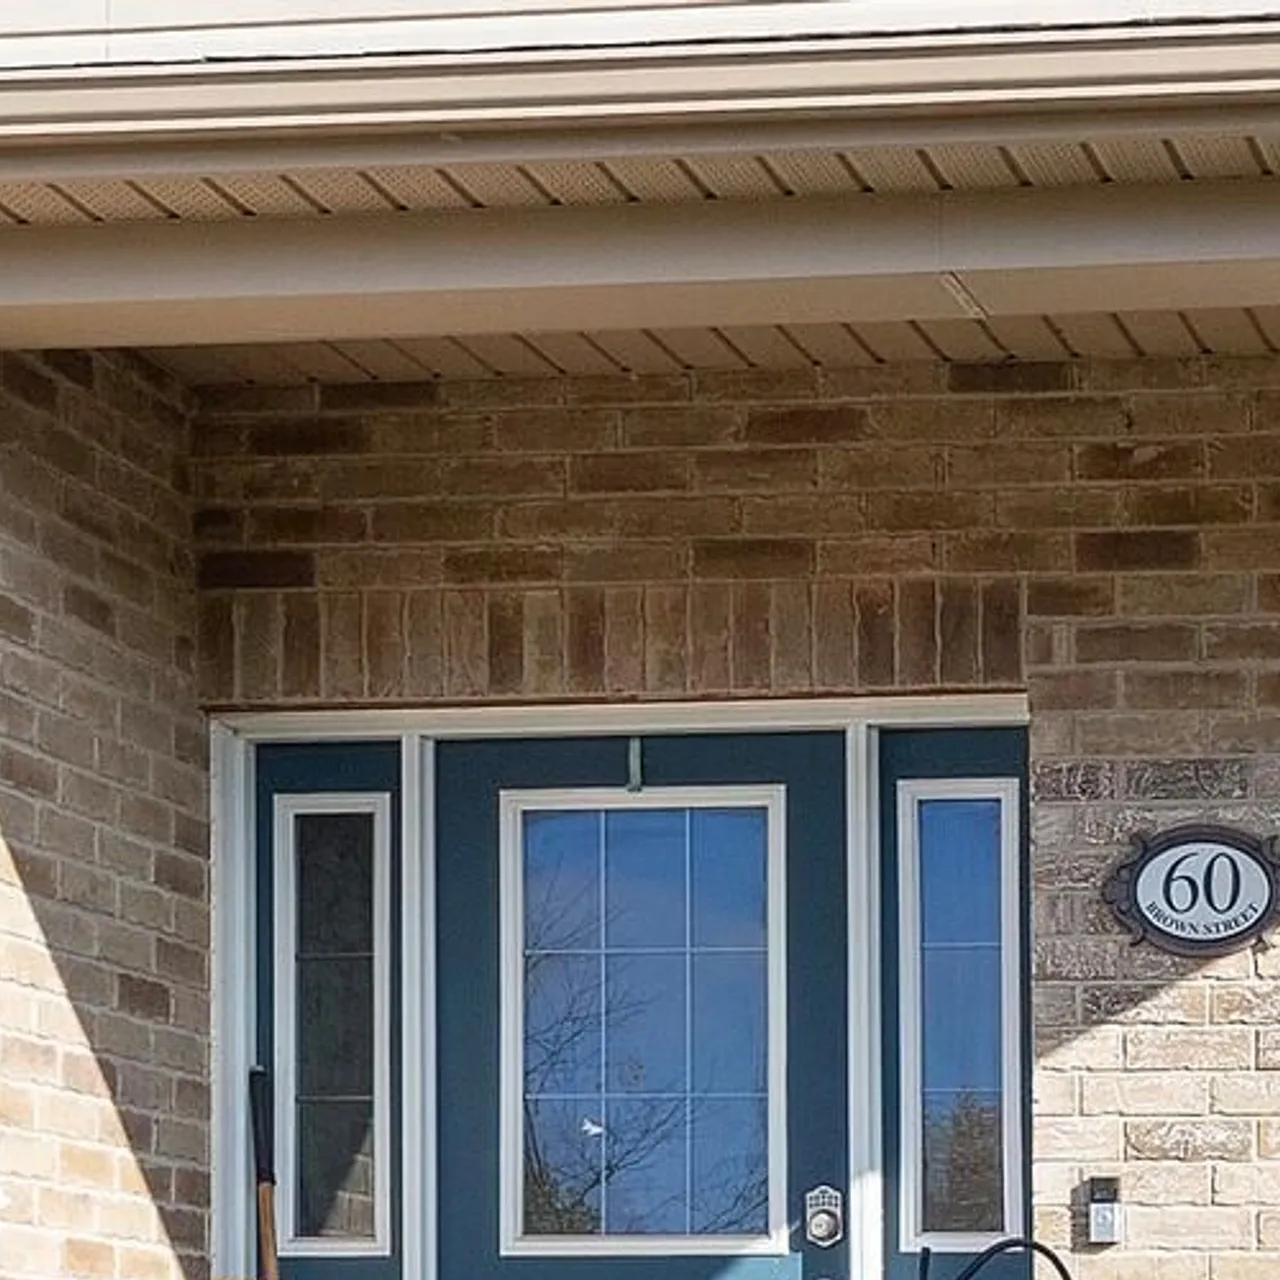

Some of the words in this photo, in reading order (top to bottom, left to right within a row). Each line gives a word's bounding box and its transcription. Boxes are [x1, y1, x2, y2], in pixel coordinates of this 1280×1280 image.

[1162, 852, 1241, 914] 60
[1146, 901, 1199, 935] BROWN
[1203, 902, 1260, 935] STREET
